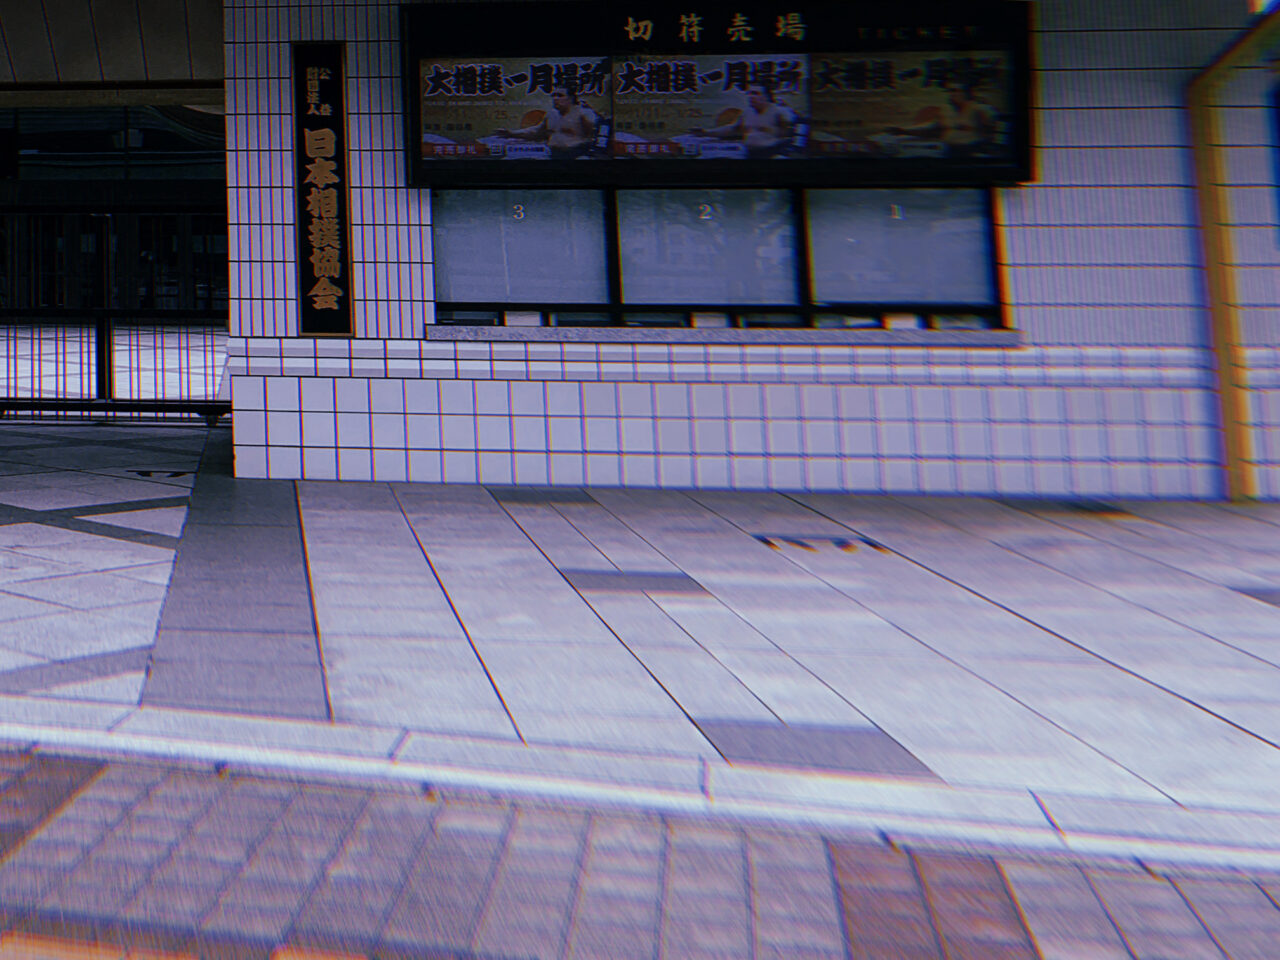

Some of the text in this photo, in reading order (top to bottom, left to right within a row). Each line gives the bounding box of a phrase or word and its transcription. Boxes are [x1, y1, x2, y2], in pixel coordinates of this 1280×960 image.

[623, 11, 808, 44] 切符売場
[425, 63, 606, 96] 大相撲一月場所
[616, 60, 804, 95] 大相撲一月場所
[302, 127, 344, 311] 日本相撲協会
[513, 204, 525, 219] 3
[699, 204, 713, 219] 2
